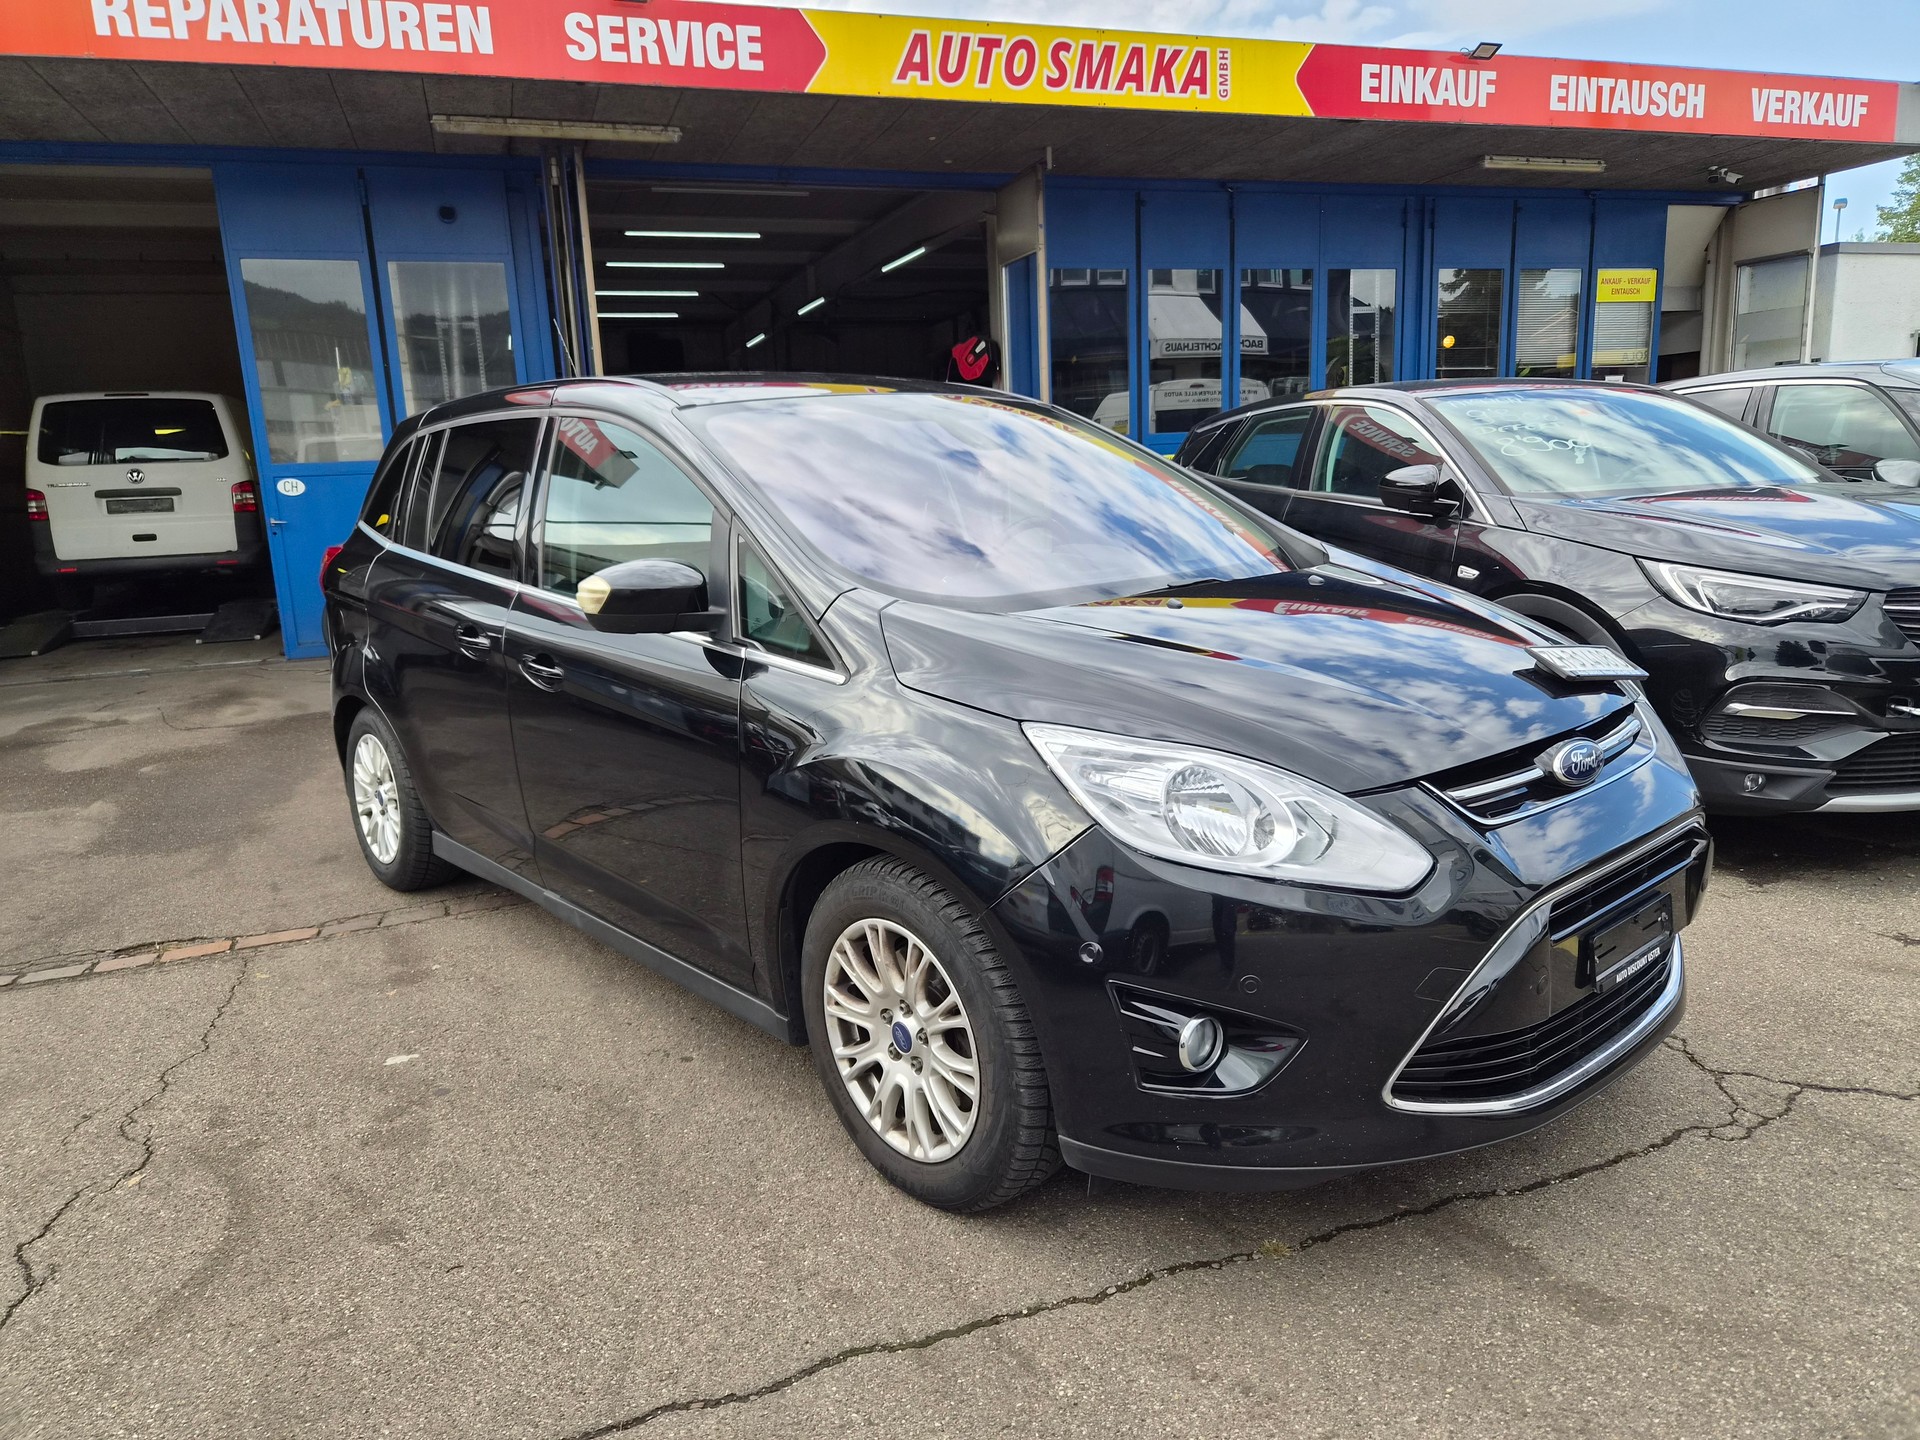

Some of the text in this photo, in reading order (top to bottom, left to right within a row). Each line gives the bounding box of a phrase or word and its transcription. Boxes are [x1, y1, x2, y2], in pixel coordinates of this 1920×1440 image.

[91, 0, 494, 55] REPARATUREN
[564, 12, 764, 72] SERVICE
[895, 31, 1229, 98] AUTO SMAKA GMBH
[1360, 63, 1497, 108] EINKAUF
[1549, 75, 1706, 119] EINTAUSCH
[1751, 87, 1869, 128] VERKAUF
[283, 481, 299, 493] CH
[1570, 747, 1598, 775] Ford
[1616, 946, 1661, 983] AUTO DISCOUNT USTER
